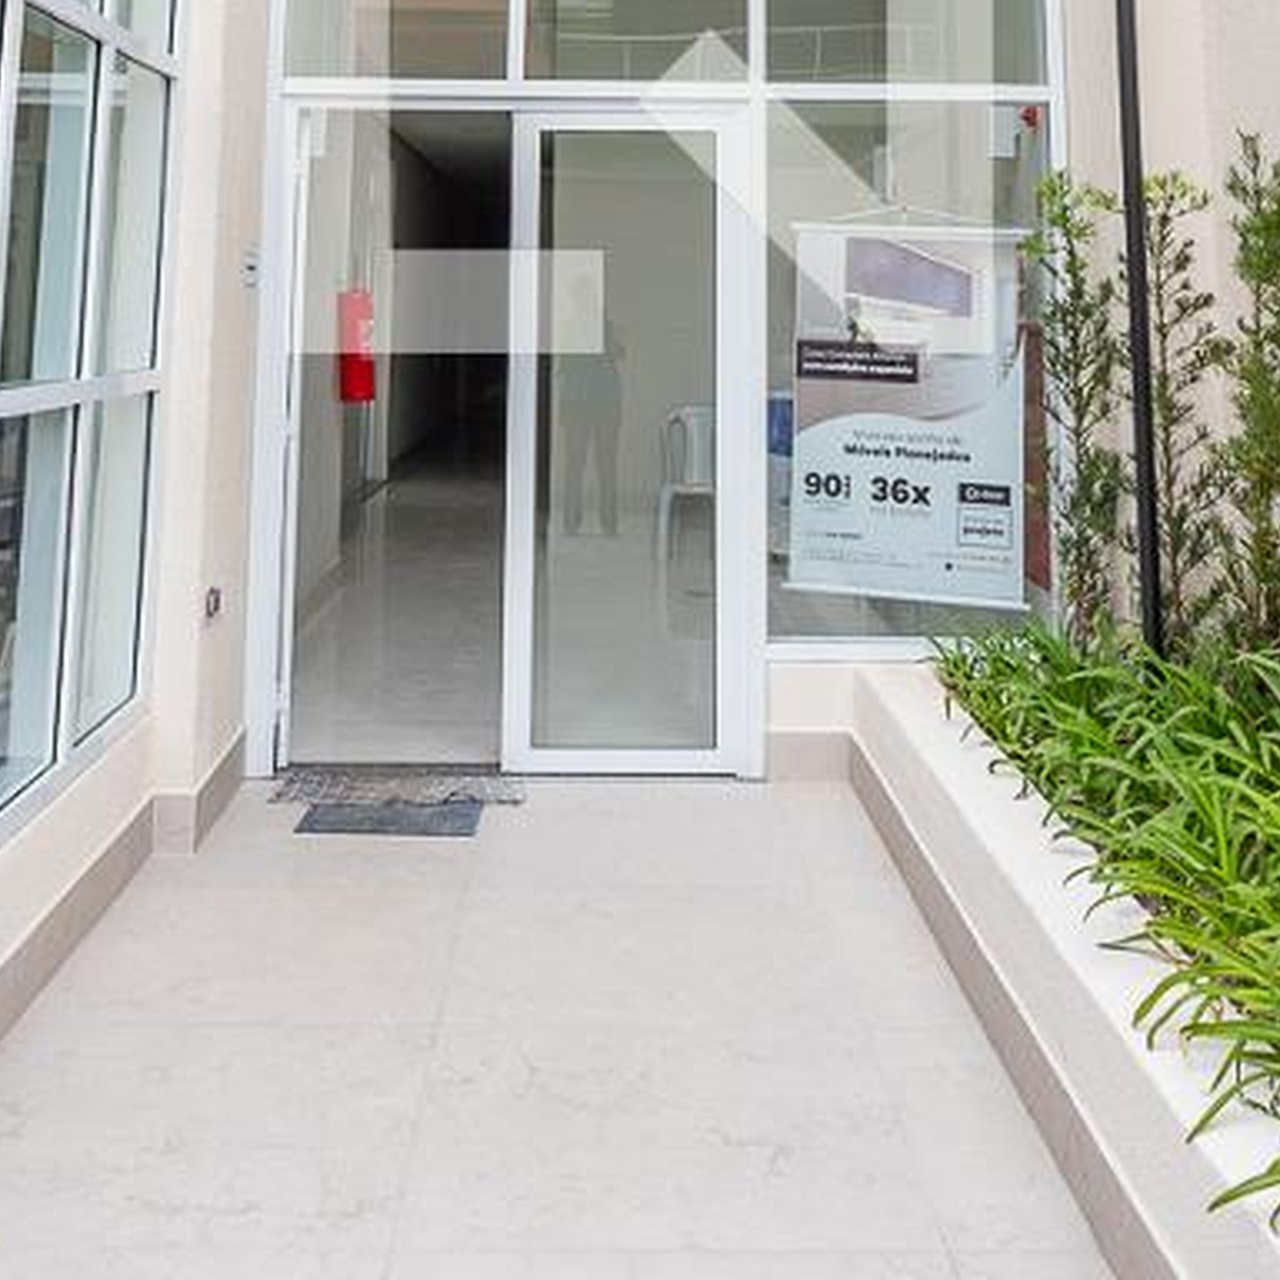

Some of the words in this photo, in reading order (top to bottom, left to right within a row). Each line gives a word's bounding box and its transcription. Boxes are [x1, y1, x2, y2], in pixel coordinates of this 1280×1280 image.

[843, 442, 892, 459] Móveis
[894, 445, 972, 465] Planejados
[804, 472, 842, 497] 90
[871, 477, 932, 507] 36x
